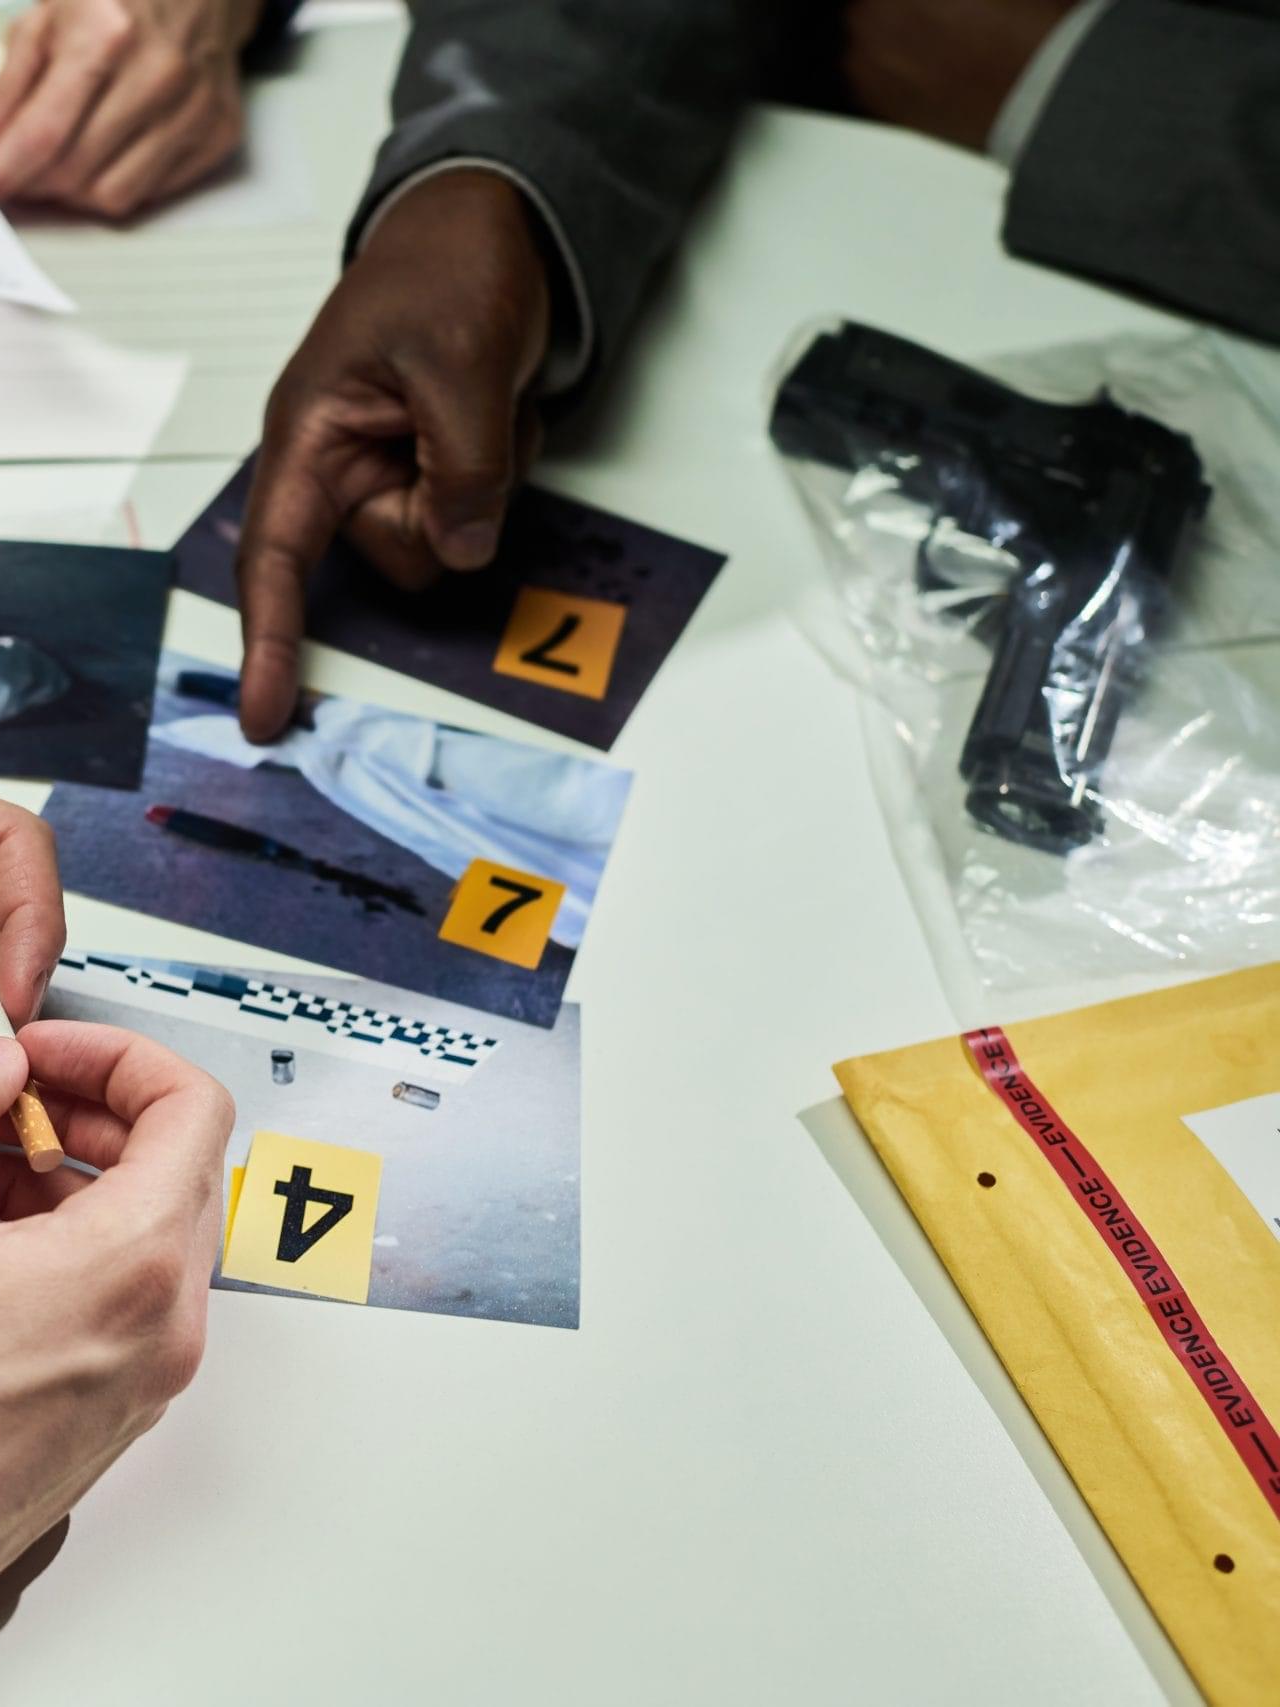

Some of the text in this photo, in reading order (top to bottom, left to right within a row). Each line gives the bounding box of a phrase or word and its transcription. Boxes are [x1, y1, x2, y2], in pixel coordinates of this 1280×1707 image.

[519, 613, 582, 677] 7
[480, 875, 544, 935] 7
[273, 1165, 354, 1263] 4
[982, 1041, 1256, 1428] EVIDENCE EVIDENCE EVIDENCE
